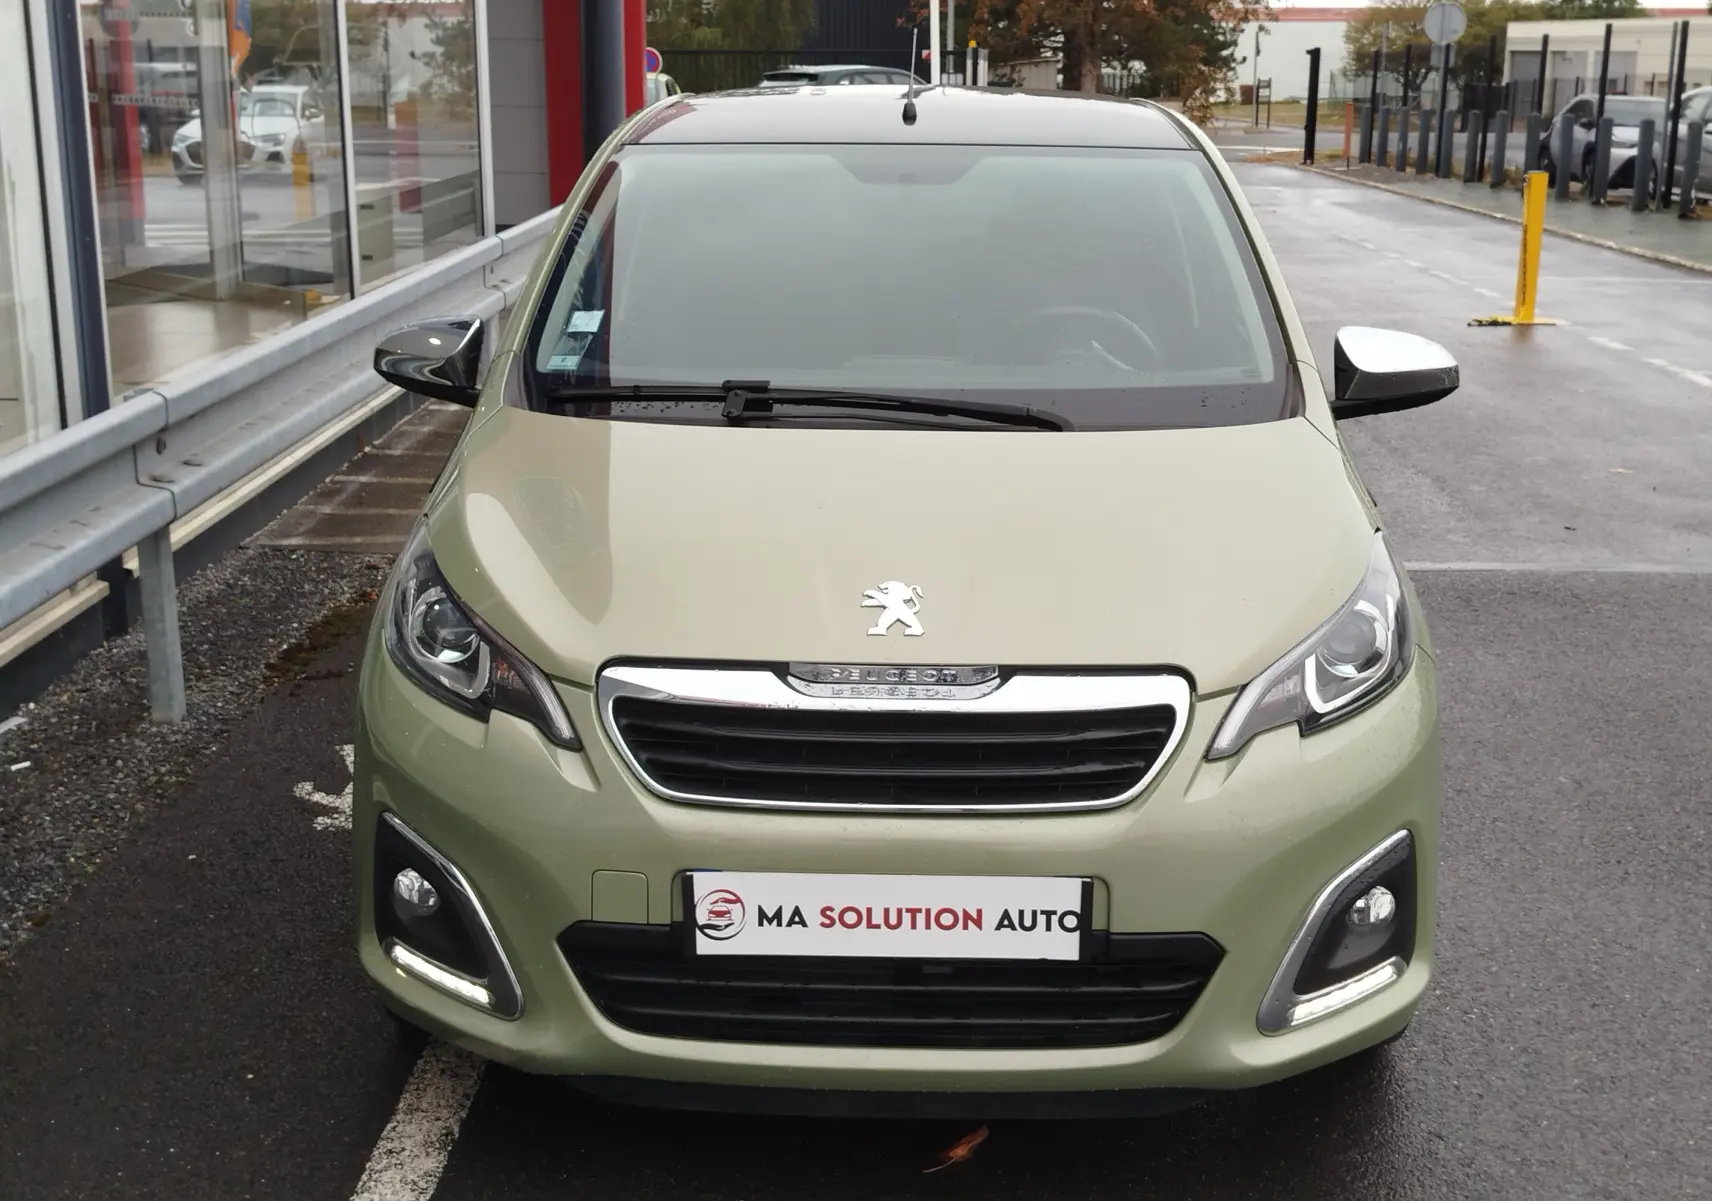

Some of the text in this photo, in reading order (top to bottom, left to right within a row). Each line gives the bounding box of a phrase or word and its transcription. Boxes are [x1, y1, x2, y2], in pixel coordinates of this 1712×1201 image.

[830, 667, 957, 681] PEUGEOT
[757, 904, 1082, 933] MA SOLUTION AUTO
